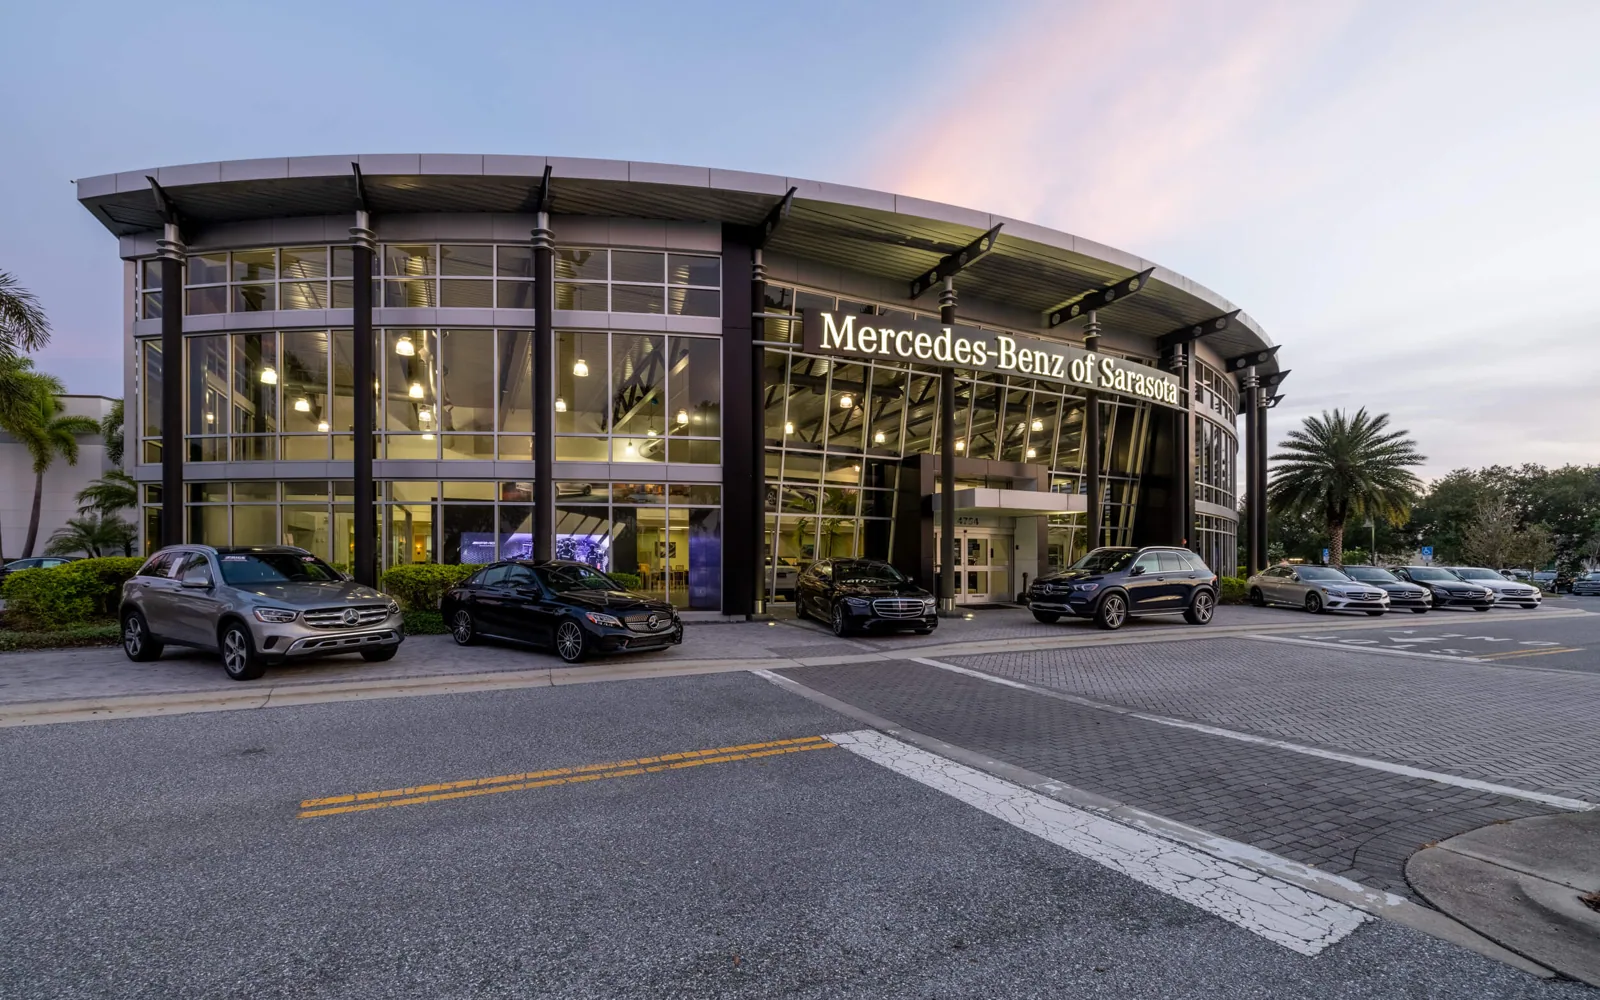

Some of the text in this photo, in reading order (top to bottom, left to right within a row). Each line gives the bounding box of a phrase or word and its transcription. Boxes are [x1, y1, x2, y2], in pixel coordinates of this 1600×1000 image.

[819, 312, 1179, 405] Mercedes-Benz of Sarasota
